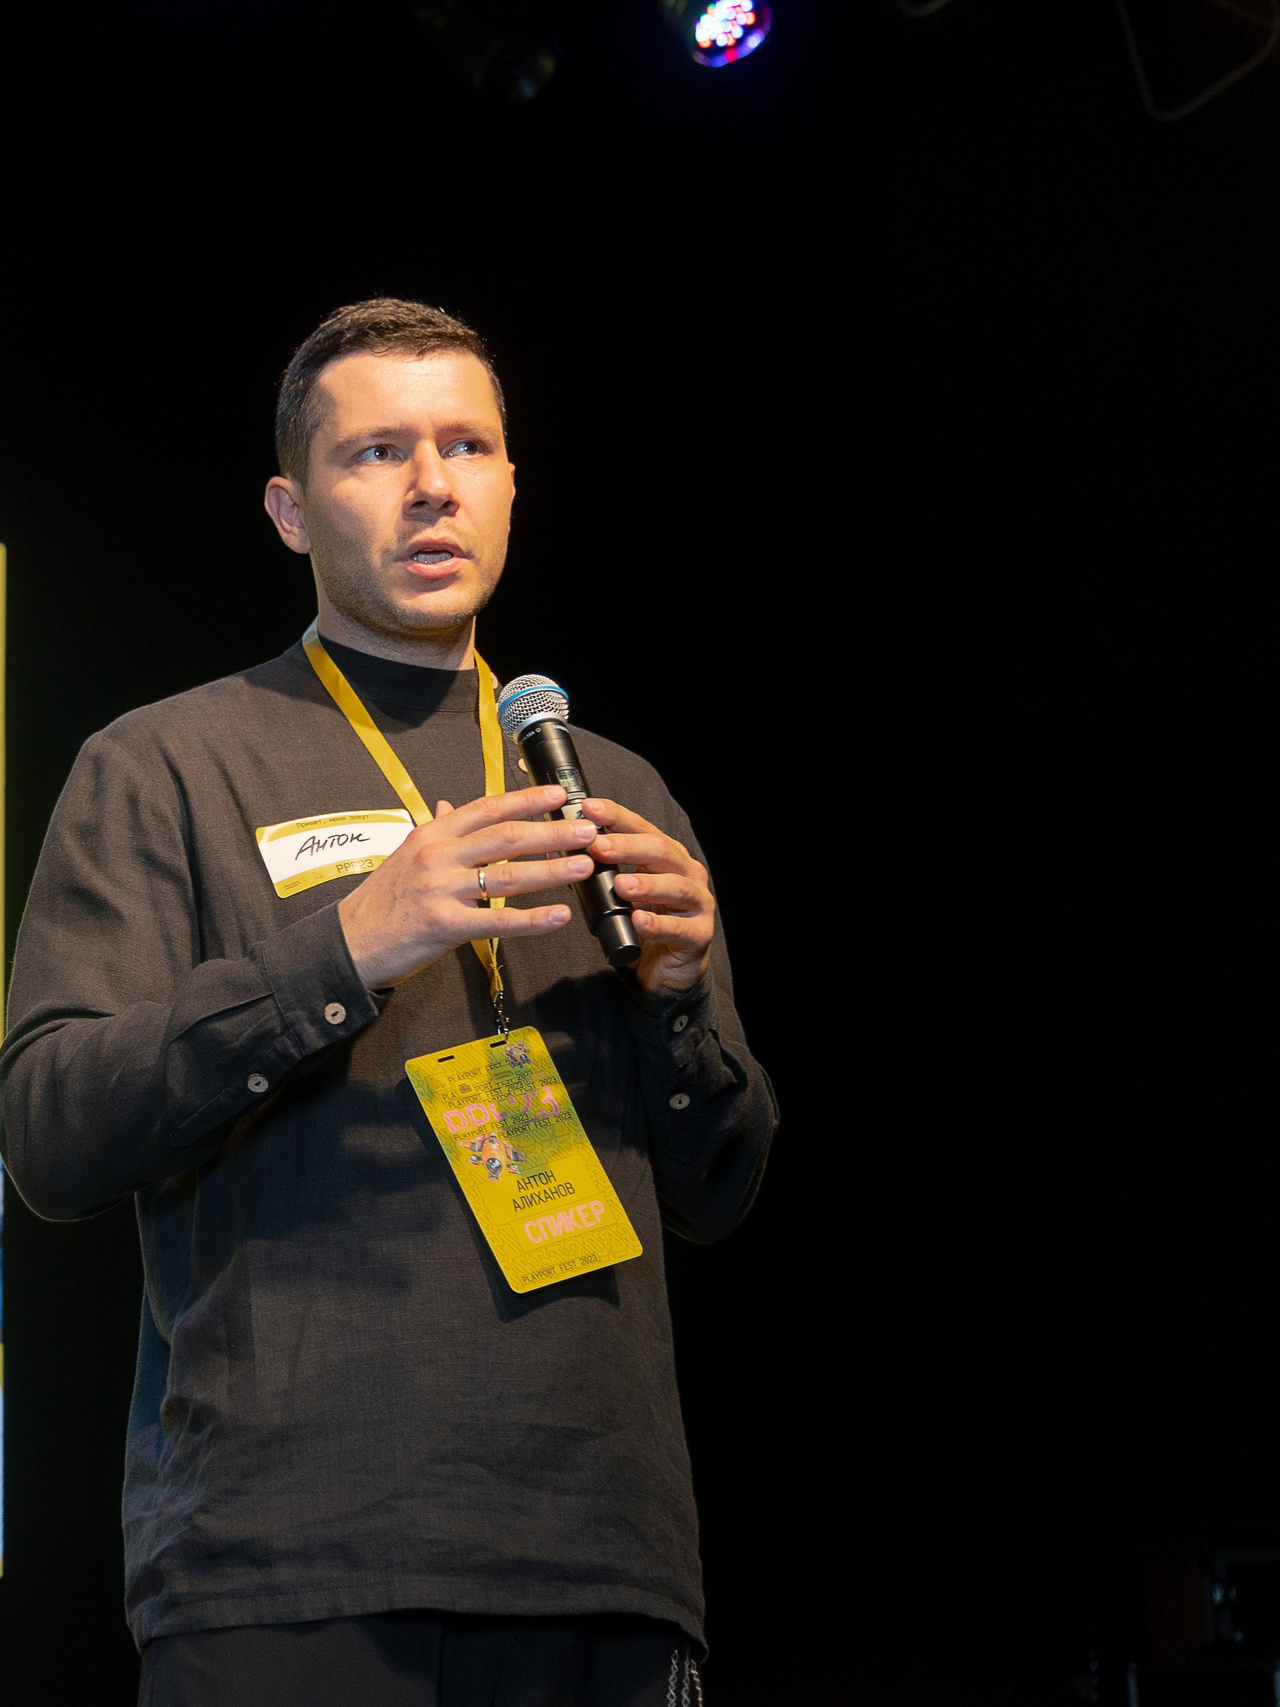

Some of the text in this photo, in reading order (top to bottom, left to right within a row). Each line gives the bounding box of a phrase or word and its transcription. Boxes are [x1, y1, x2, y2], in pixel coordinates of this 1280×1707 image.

[336, 859, 374, 873] PPF23
[516, 1170, 557, 1193] АНТОН
[512, 1182, 576, 1212] АЛИХАНОВ
[523, 1200, 605, 1244] СПИКЕР
[522, 1267, 557, 1284] PLAYPORT
[560, 1260, 578, 1272] FEST
